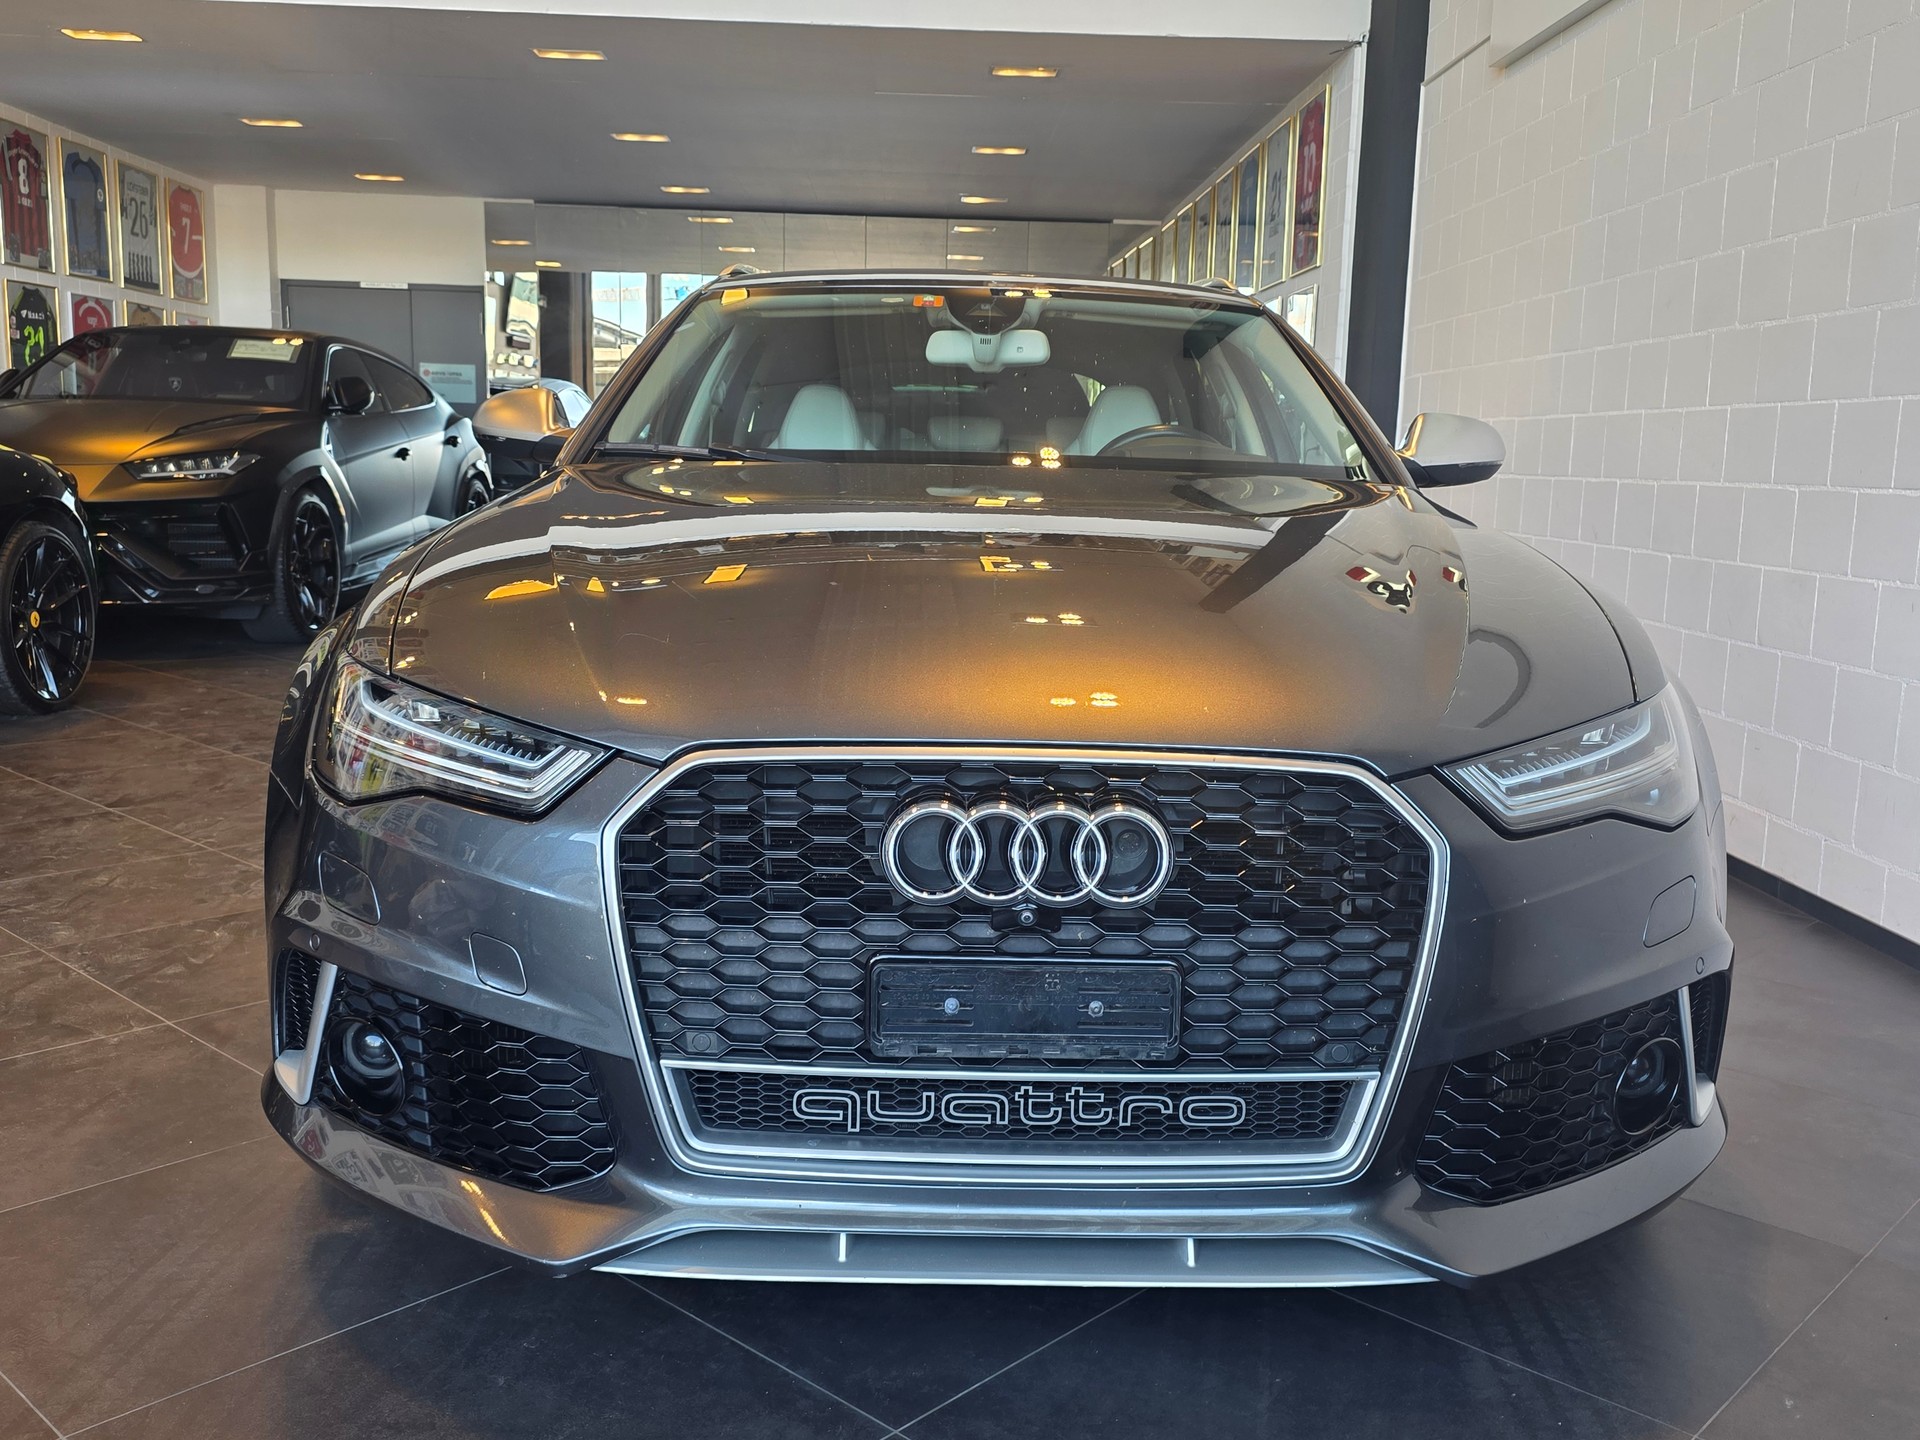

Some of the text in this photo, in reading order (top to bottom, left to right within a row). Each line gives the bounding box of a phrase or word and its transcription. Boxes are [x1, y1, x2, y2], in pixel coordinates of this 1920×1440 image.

[17, 158, 30, 195] 8
[129, 197, 148, 240] 26
[181, 217, 191, 254] 7
[23, 325, 45, 367] 21
[793, 1086, 1246, 1132] quattro
